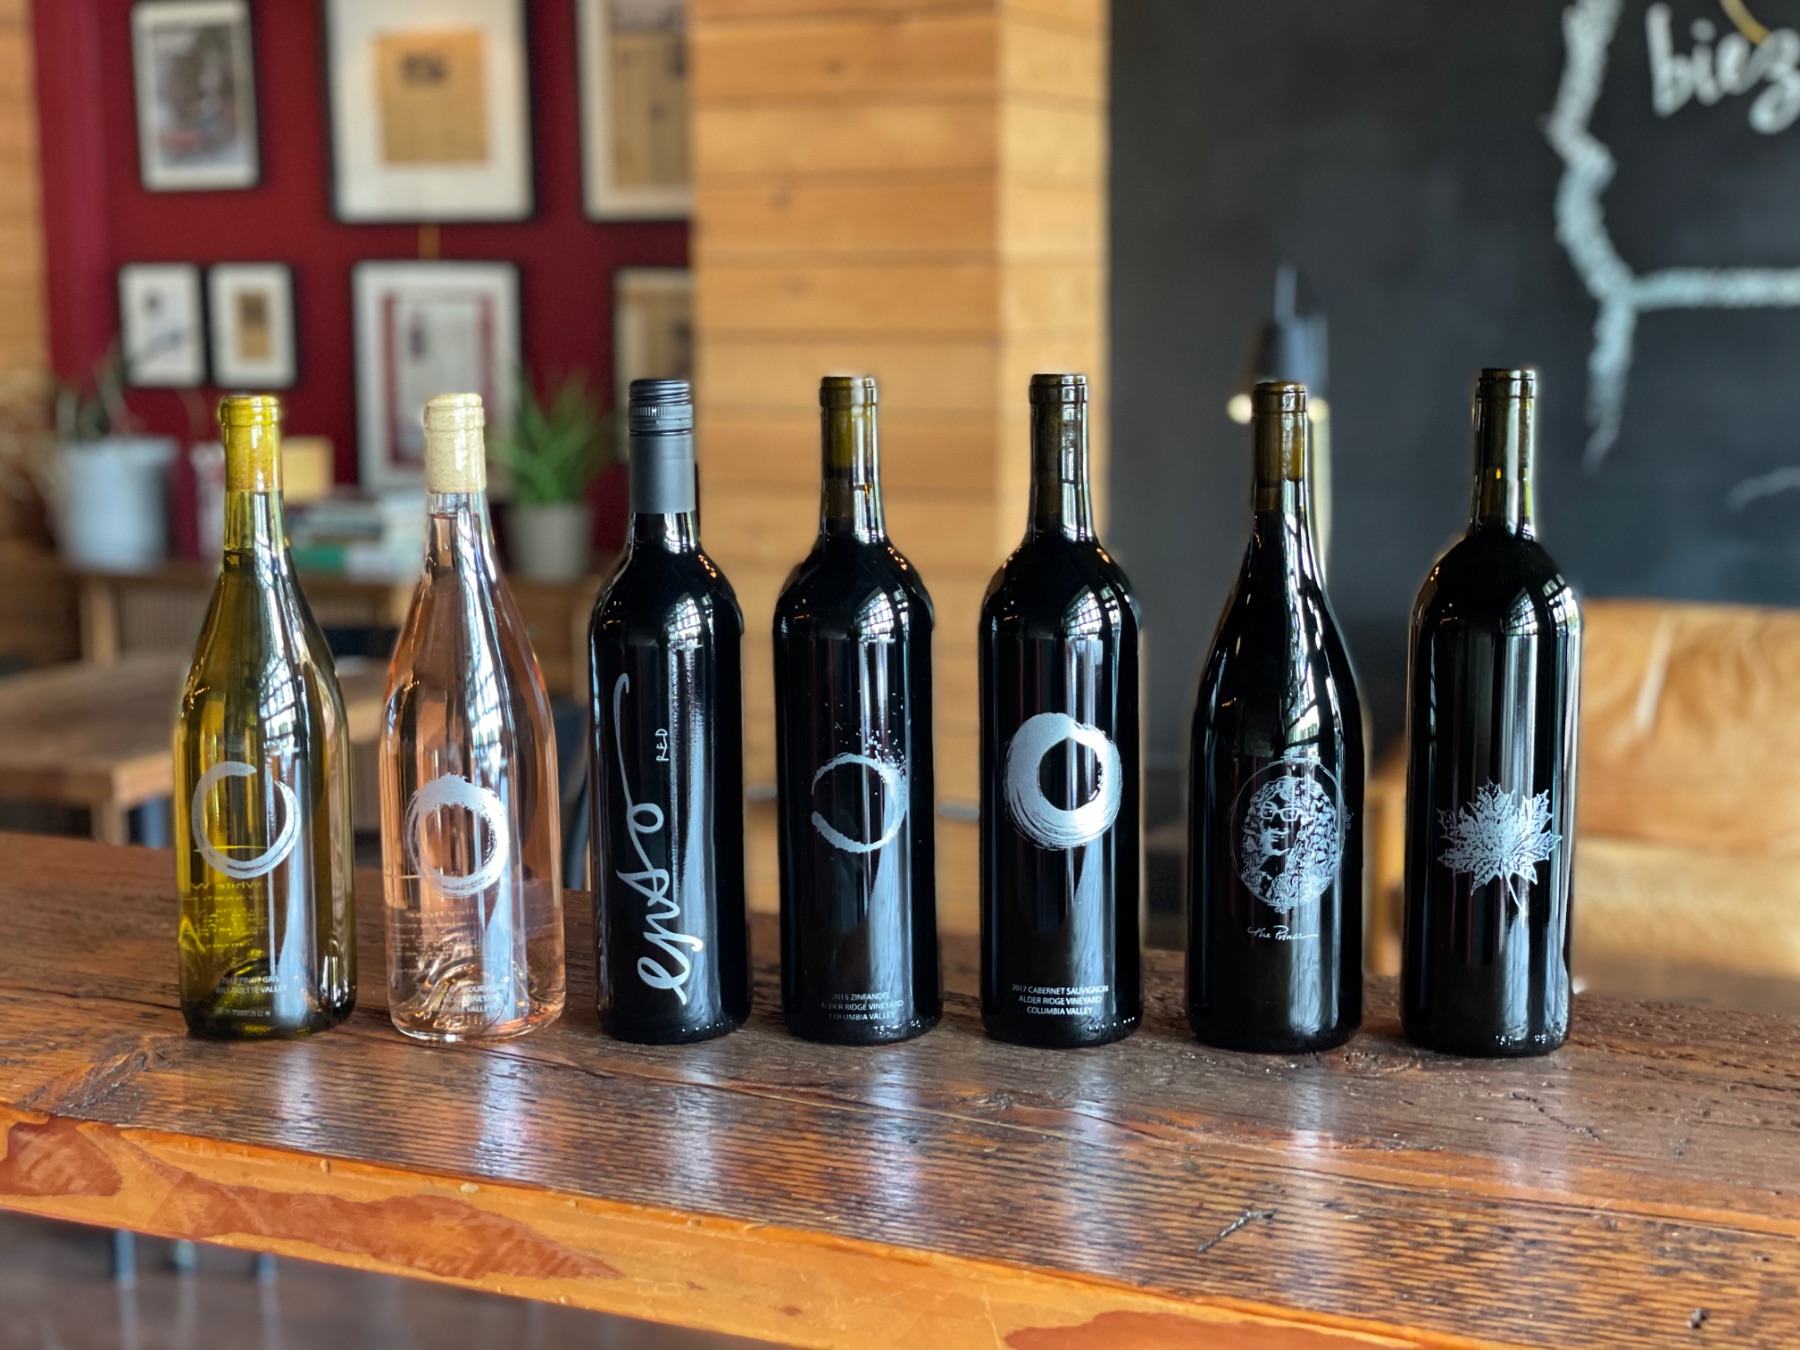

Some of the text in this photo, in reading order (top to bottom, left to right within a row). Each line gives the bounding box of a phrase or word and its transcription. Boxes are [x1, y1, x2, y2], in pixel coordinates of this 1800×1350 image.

[655, 728, 669, 761] RED
[1247, 926, 1271, 938] The
[262, 974, 280, 983] GRIS
[260, 983, 289, 994] VALLEY
[1011, 983, 1109, 995] 2017 CABERNET SAUVIGNON
[850, 991, 891, 1001] ZINFANDEL
[1018, 994, 1102, 1006] ALDER RIDGE VINEYARD
[466, 1004, 494, 1013] VALLEY
[844, 1002, 867, 1011] RIDGE
[868, 999, 904, 1011] VINEYARD
[1026, 1005, 1094, 1016] COLUMBIA VALLEY
[828, 1010, 896, 1021] COLUMBIA VALLEY
